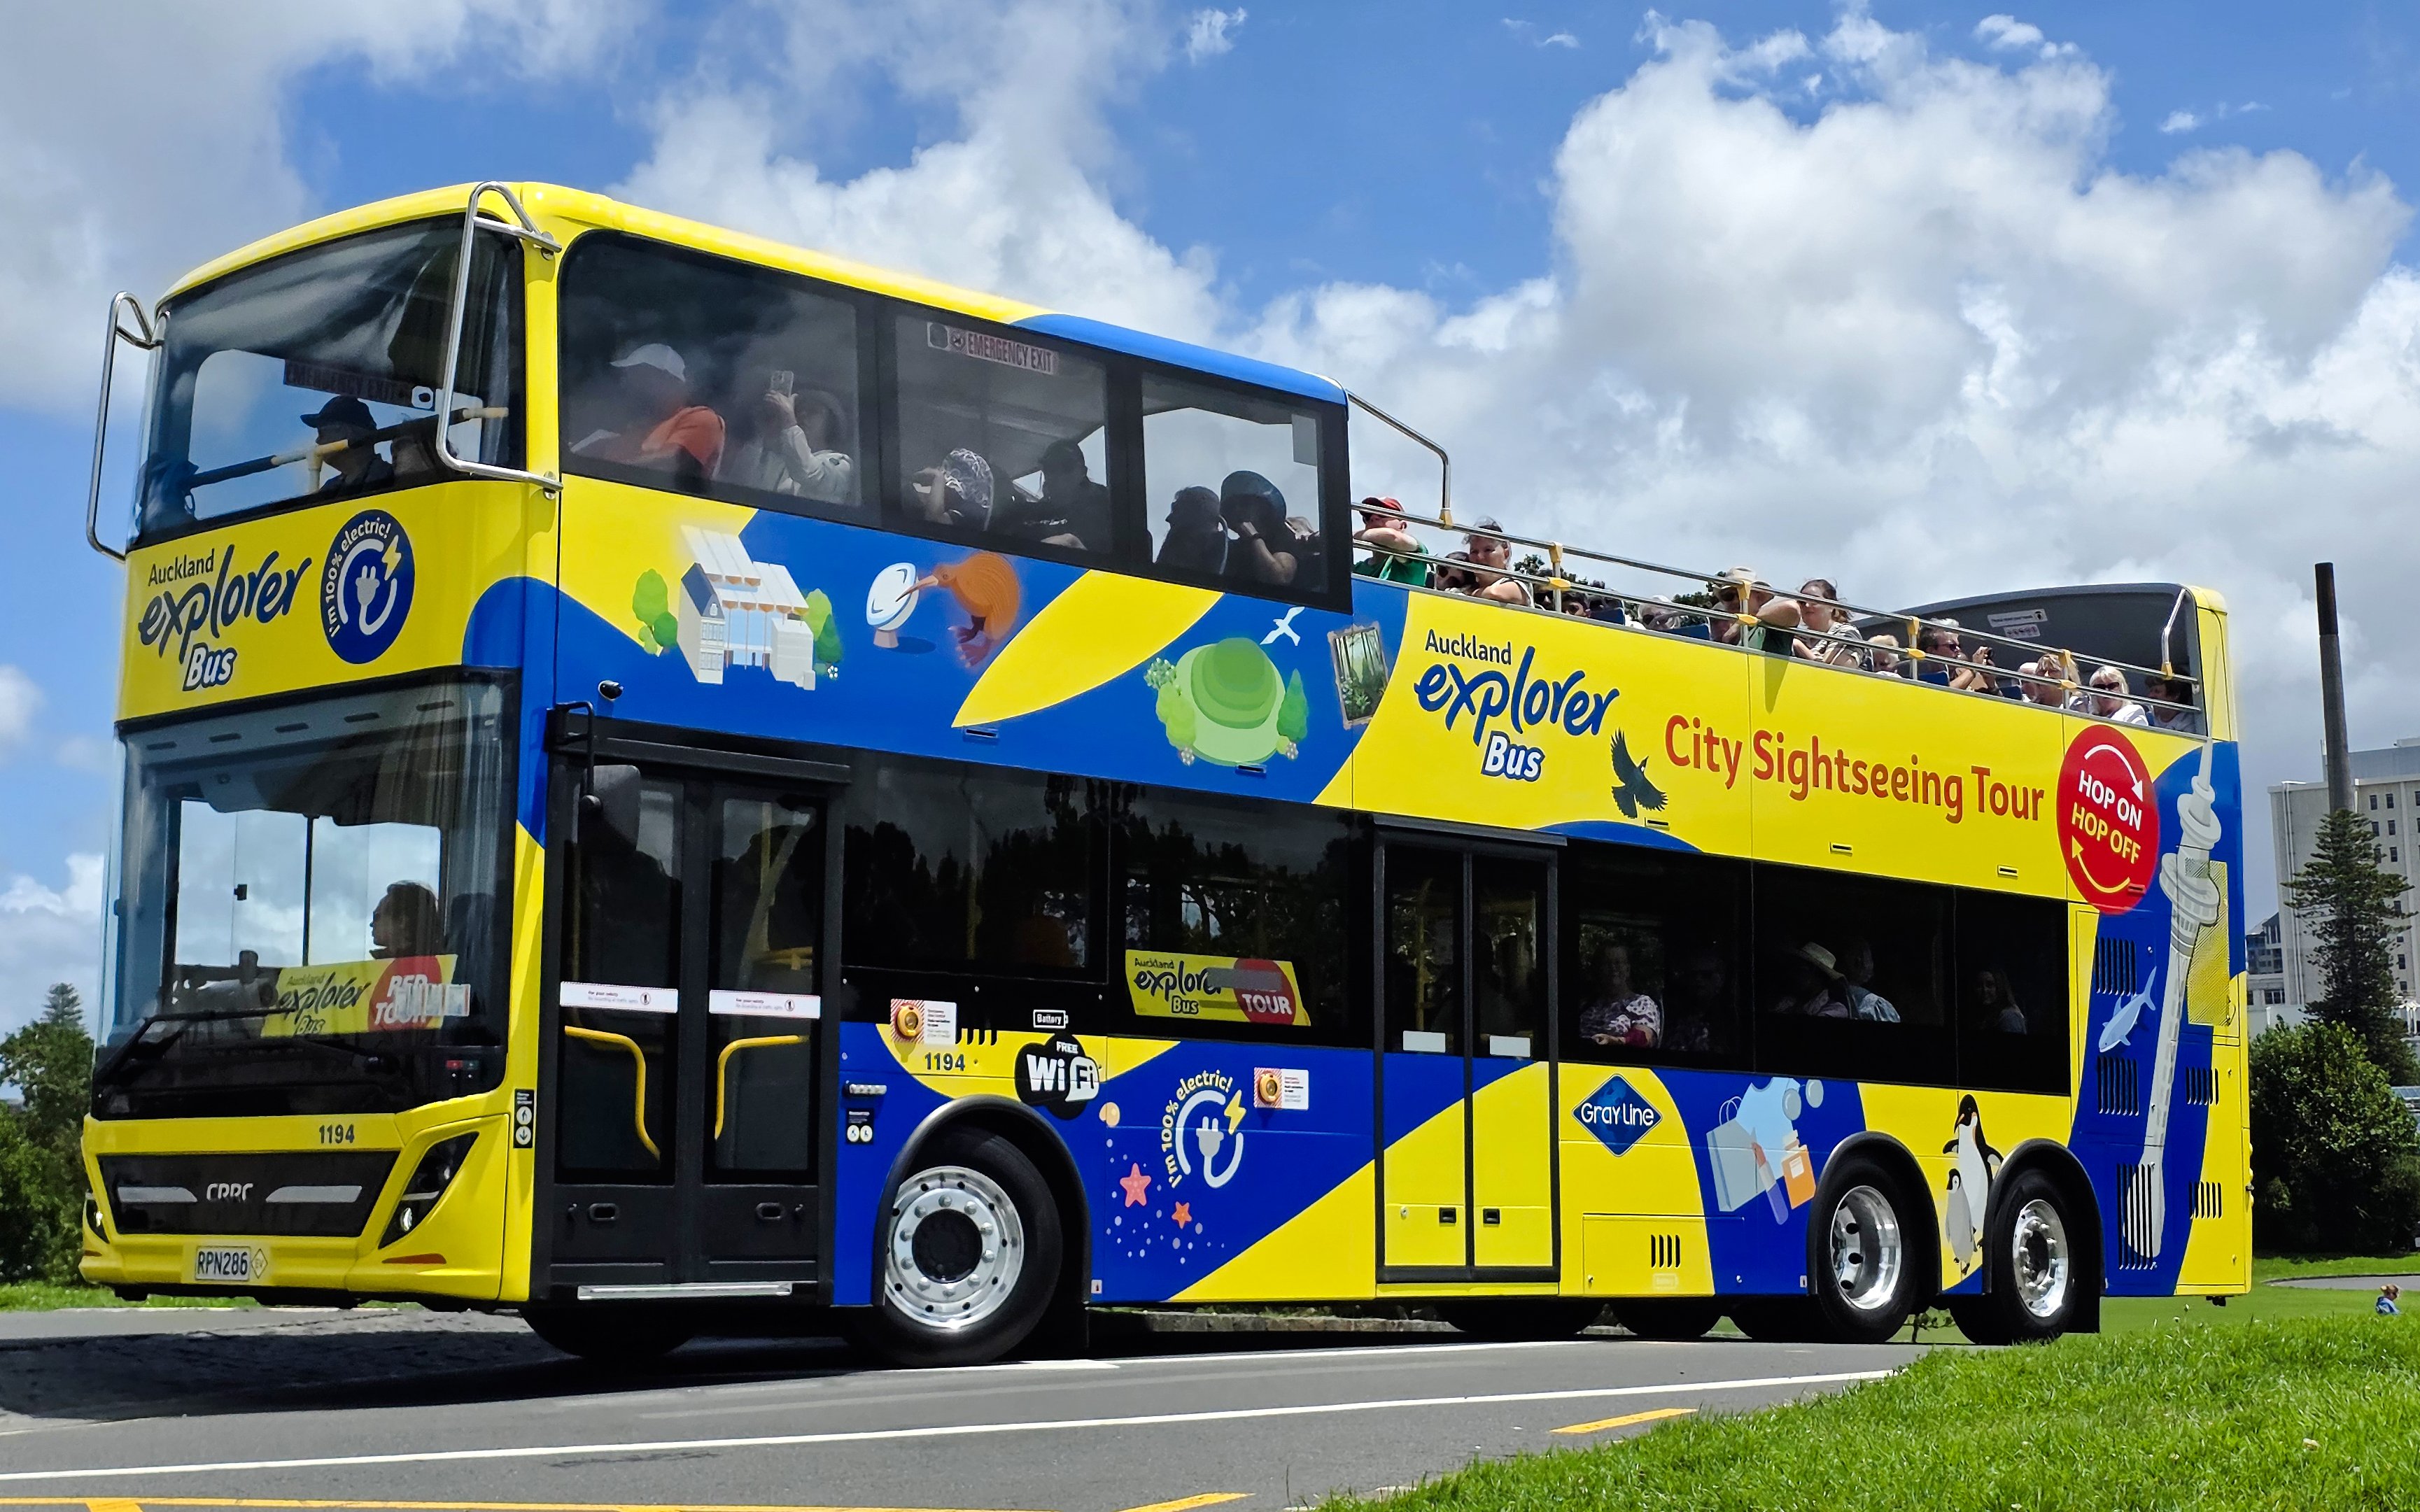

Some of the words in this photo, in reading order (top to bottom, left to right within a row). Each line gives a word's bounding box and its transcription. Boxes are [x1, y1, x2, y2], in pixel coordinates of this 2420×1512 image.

[967, 333, 1028, 367] EMERGENCY
[1031, 348, 1052, 372] EXIT
[148, 548, 215, 586] Auckland
[325, 552, 343, 603] 100%
[341, 517, 391, 552] electric!
[138, 544, 312, 665] explorer
[1425, 628, 1512, 665] Auckland
[183, 642, 237, 691] Bus
[1414, 645, 1619, 747] explorer
[1481, 730, 1545, 782] Bus
[1665, 714, 1743, 789] City
[1752, 729, 1962, 824] Sightseeing
[1971, 765, 2045, 821] Tour
[2078, 770, 2116, 810] HOP
[2117, 797, 2142, 831] ON
[2071, 802, 2109, 841] HOP
[2110, 829, 2141, 864] OFF
[1133, 960, 1222, 1001] explore
[1134, 957, 1175, 970] Auckland
[279, 971, 372, 1025] explorer
[1172, 995, 1200, 1015] Bus
[1241, 994, 1293, 1015] TOUR
[295, 1015, 325, 1036] Bus
[1036, 1013, 1062, 1025] Battery
[924, 1052, 965, 1071] 1194
[1057, 1040, 1078, 1054] FREE
[1161, 1099, 1179, 1153] 100%
[1176, 1069, 1233, 1101] electric!
[318, 1124, 355, 1144] 1194
[197, 1251, 248, 1276] RPN286
